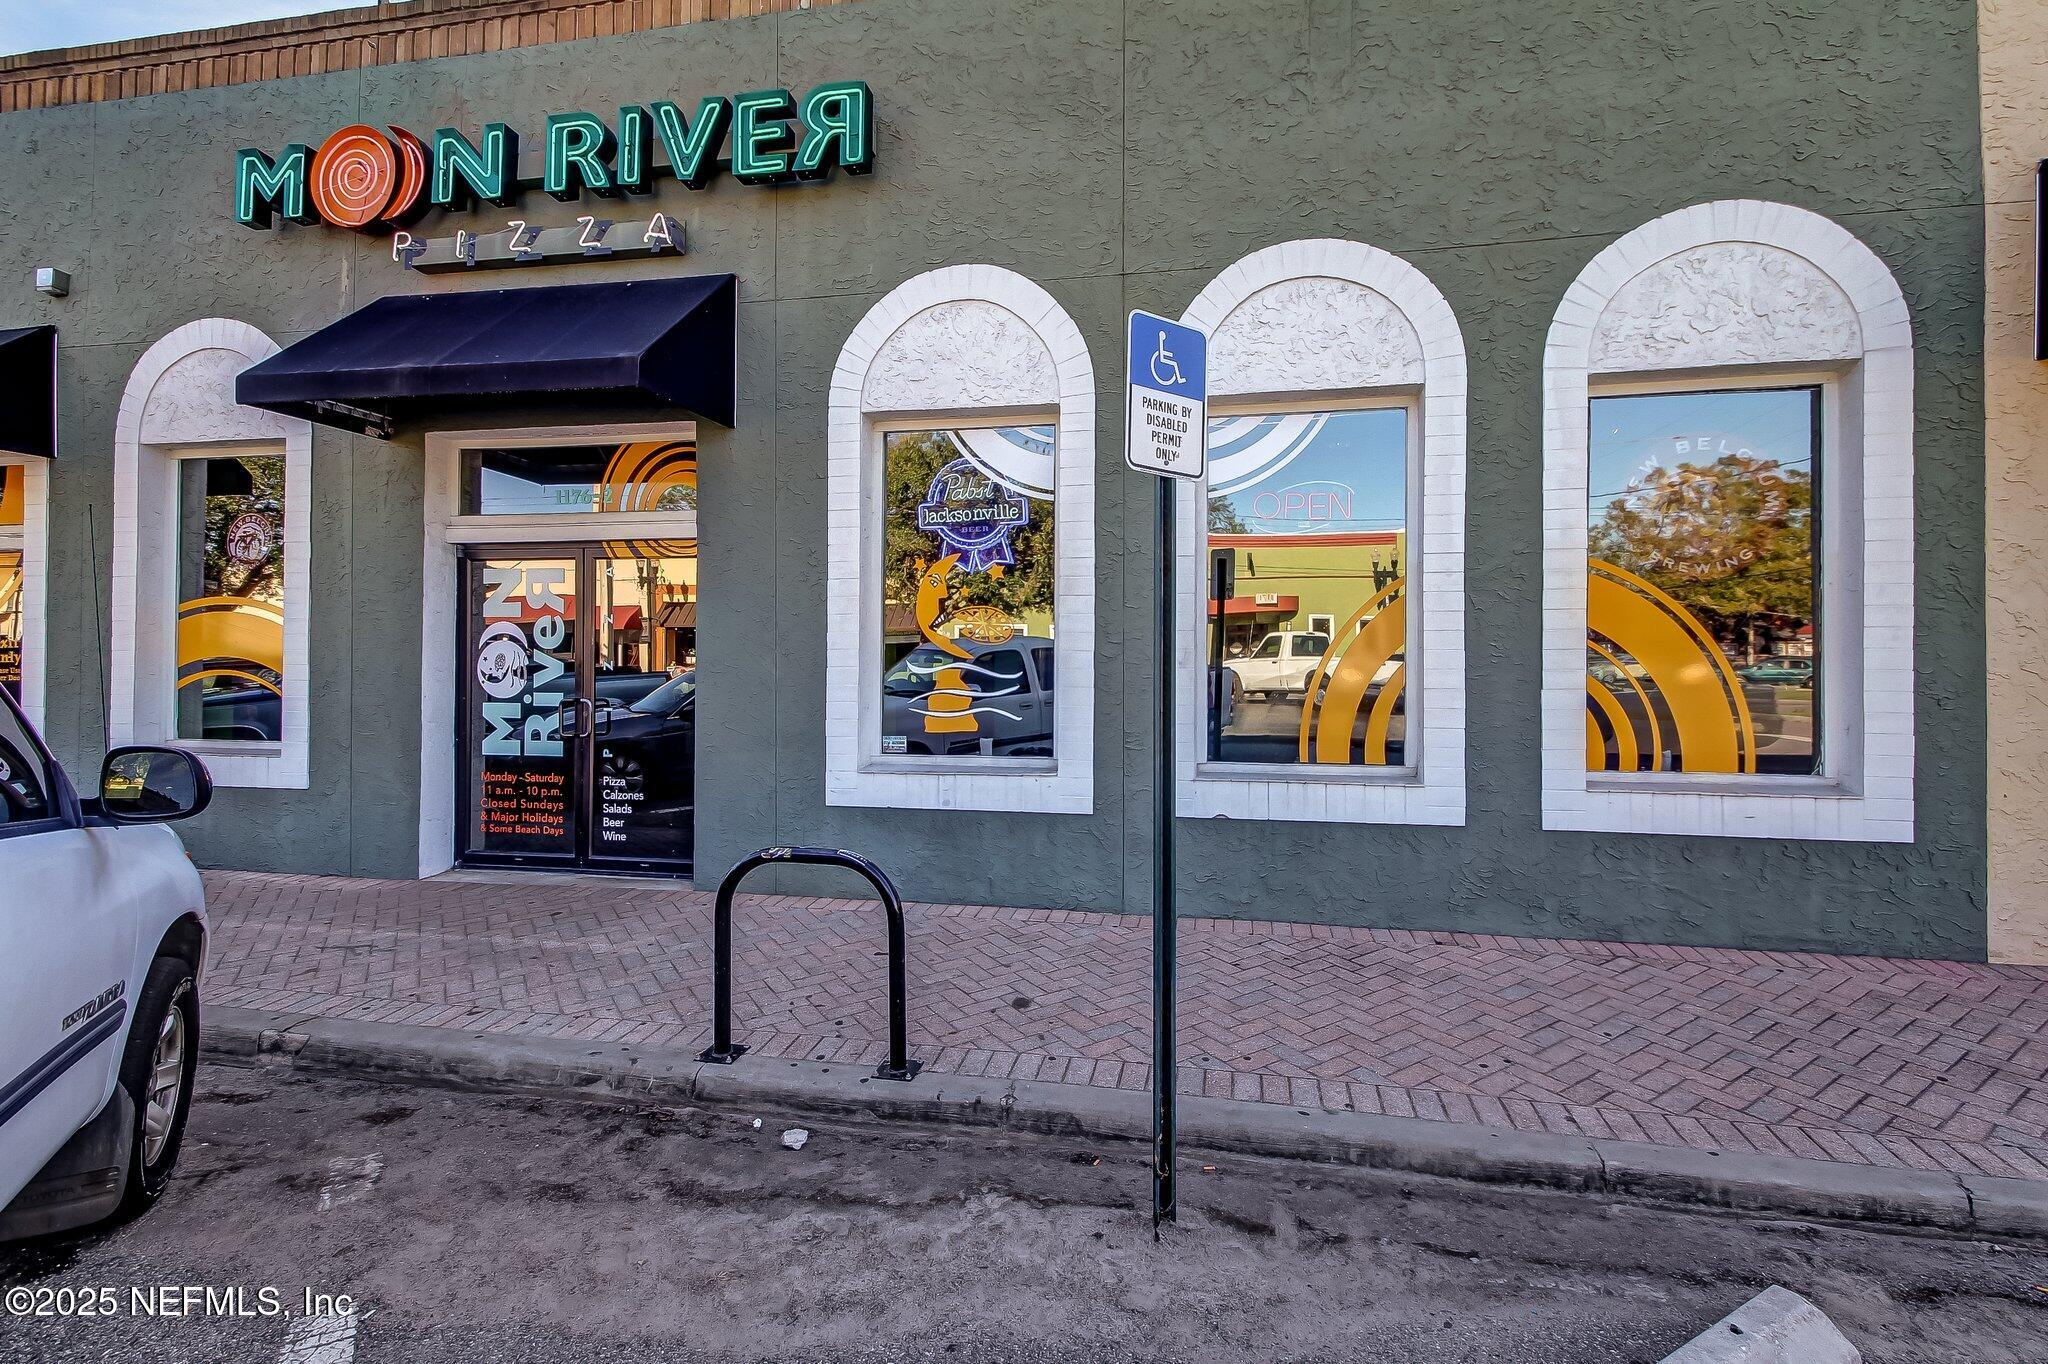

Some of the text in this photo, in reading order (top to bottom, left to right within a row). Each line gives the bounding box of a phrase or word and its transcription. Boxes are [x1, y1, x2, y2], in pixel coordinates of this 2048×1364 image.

[544, 81, 868, 196] RIVER
[393, 212, 680, 266] PIZZA
[1142, 396, 1193, 419] PARKING BY
[1146, 413, 1188, 434] DISABLED
[1151, 431, 1183, 448] PERMIT
[1155, 447, 1177, 462] ONLY
[942, 473, 995, 501] Pabst
[1253, 491, 1352, 520] OPEN
[923, 504, 1020, 524] Jacksonville
[961, 525, 989, 533] BEER
[480, 771, 518, 784] Monday
[524, 772, 565, 786] Saturday
[602, 775, 626, 787] Pizza
[481, 785, 492, 795] 11
[495, 786, 516, 795] a.m.
[526, 786, 538, 796] 10
[541, 787, 563, 798] p.m.
[602, 789, 645, 801] Calzones
[480, 797, 564, 812] Closed Sundays
[602, 803, 633, 814] Salads
[480, 810, 564, 826] & Major Holidays
[602, 816, 625, 828] Beer
[480, 823, 564, 837] & Some Beach Days
[602, 830, 627, 842] Wine
